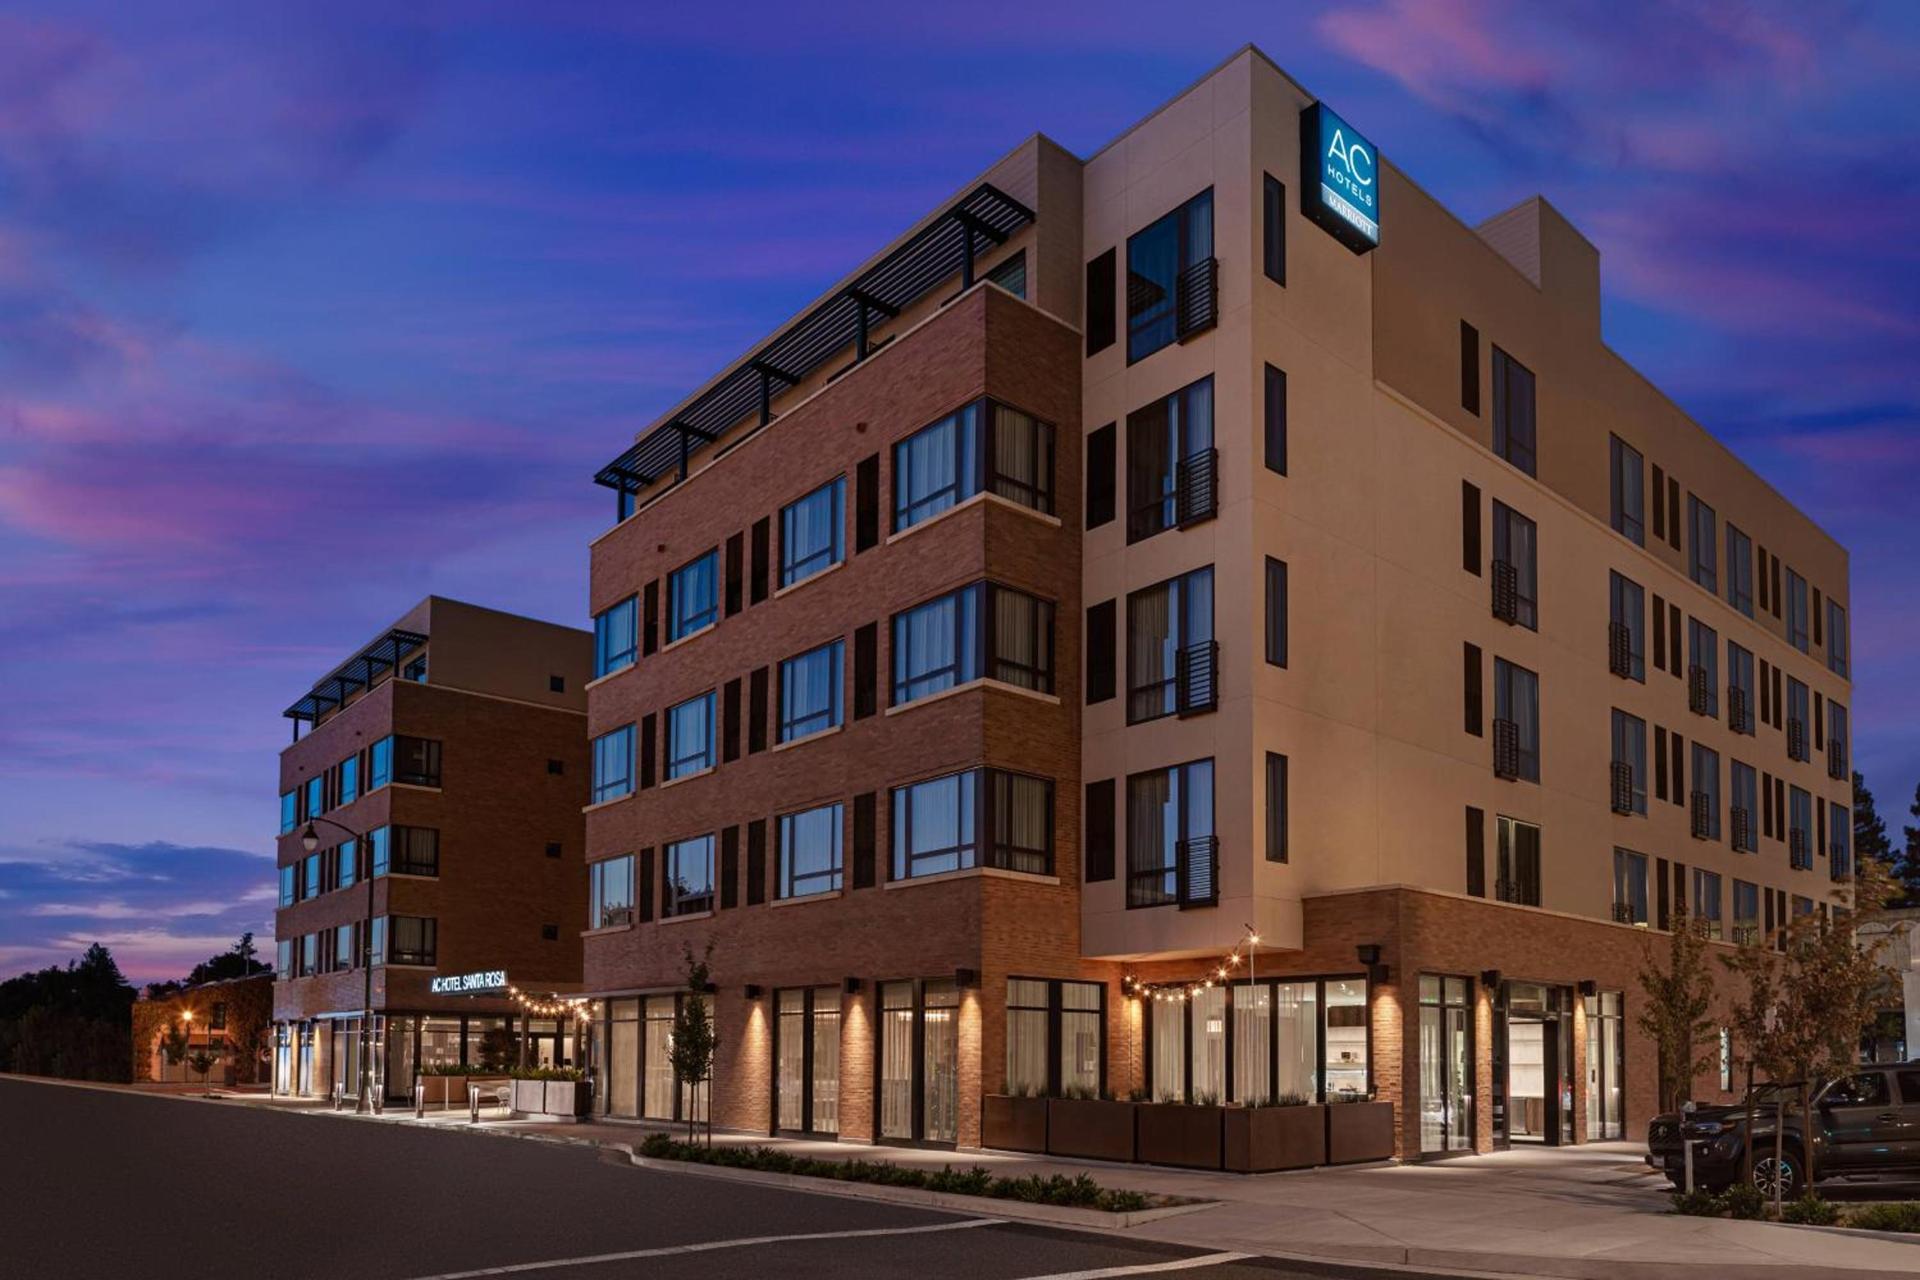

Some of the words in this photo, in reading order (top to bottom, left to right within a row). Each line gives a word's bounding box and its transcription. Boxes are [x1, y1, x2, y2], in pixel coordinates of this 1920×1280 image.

[1328, 129, 1371, 186] AC
[1327, 164, 1372, 207] HOTELS
[1329, 194, 1372, 236] MARRIOTT
[431, 978, 441, 992] AC
[441, 976, 462, 992] HOTEL
[462, 973, 485, 990] SANTA
[485, 971, 505, 987] ROSA
